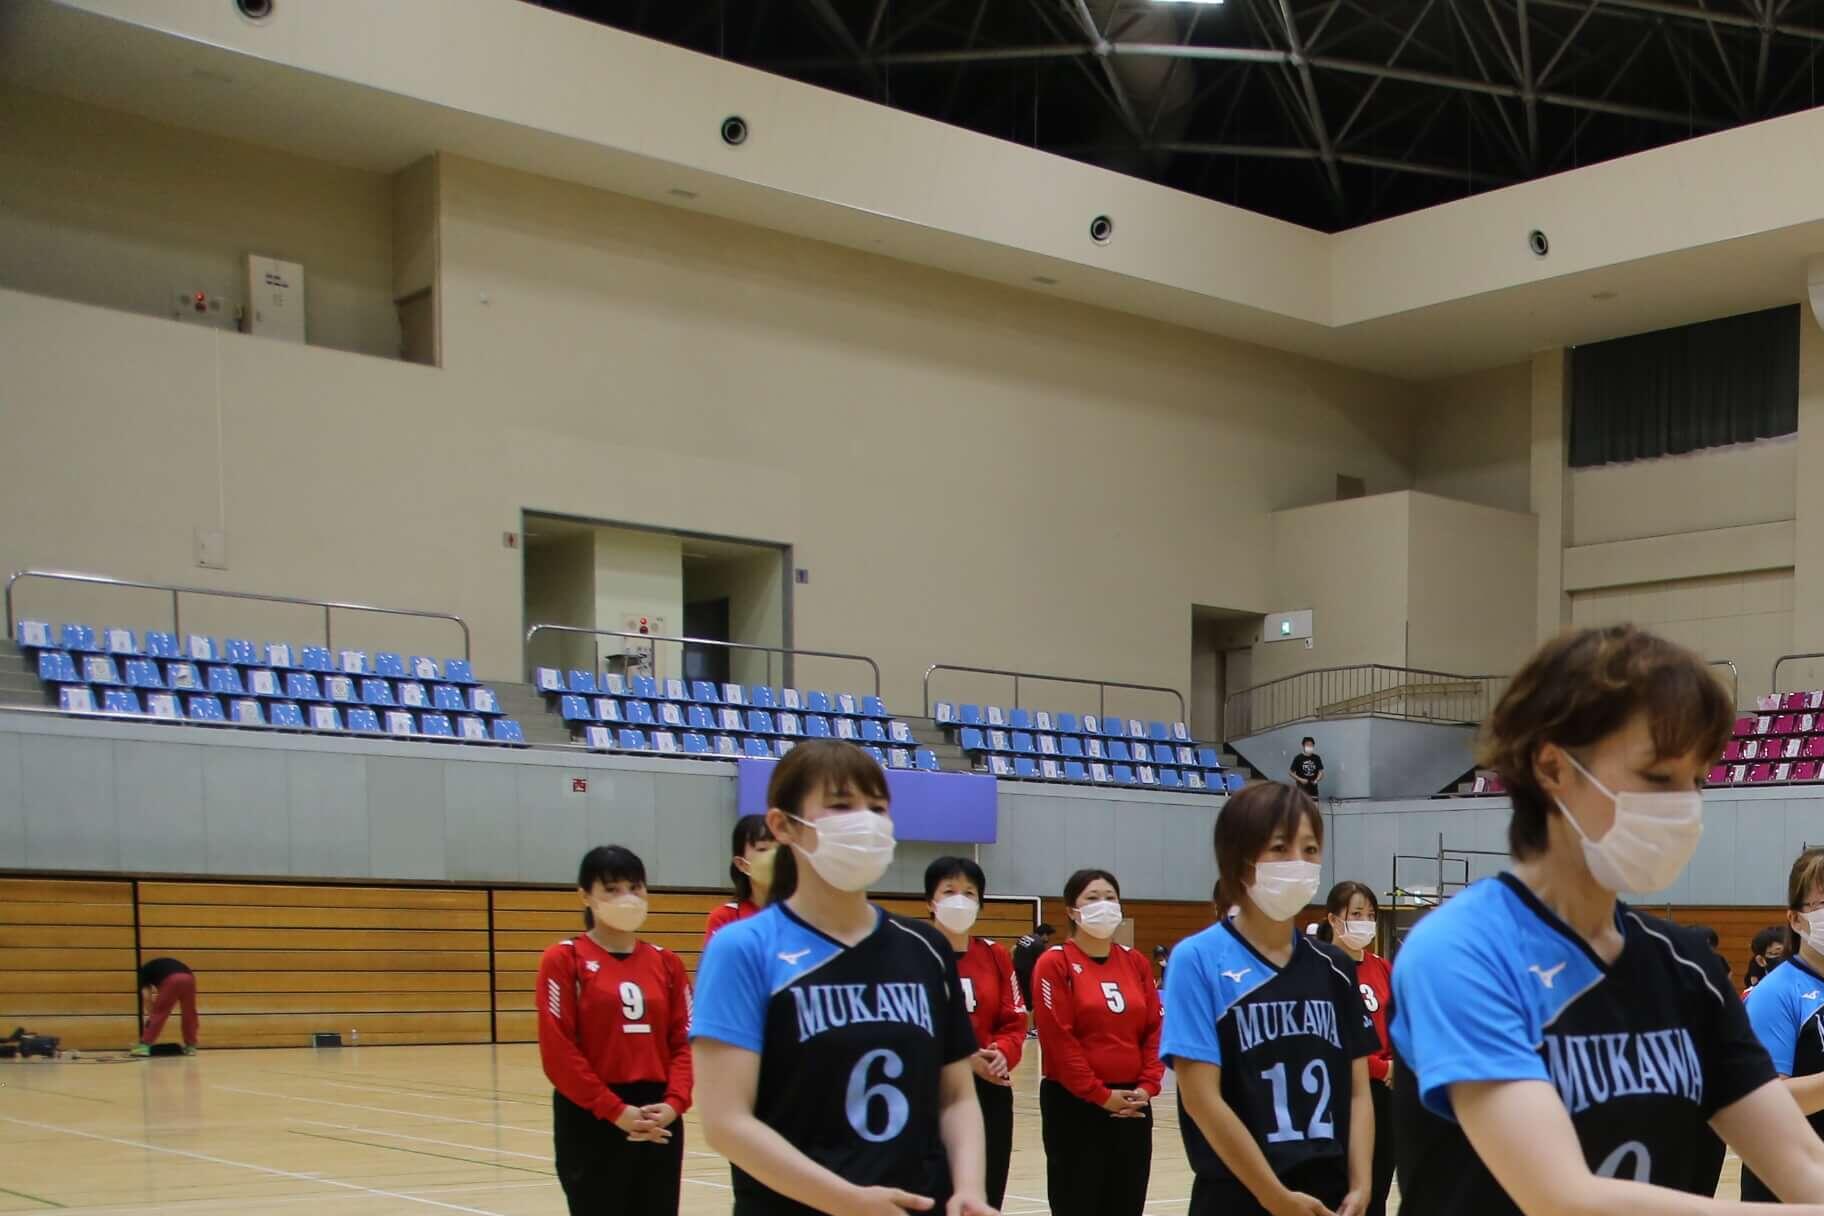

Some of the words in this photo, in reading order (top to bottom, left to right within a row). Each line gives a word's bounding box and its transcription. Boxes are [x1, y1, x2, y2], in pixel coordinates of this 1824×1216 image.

[617, 981, 646, 1021] 9
[792, 982, 935, 1043] MUKAWA
[1100, 981, 1127, 1014] 5
[1359, 983, 1379, 1012] 3
[1233, 1000, 1343, 1054] MUKAWA
[845, 1047, 910, 1143] 6
[1261, 1057, 1335, 1143] 12
[1544, 1027, 1704, 1117] MUKAWA
